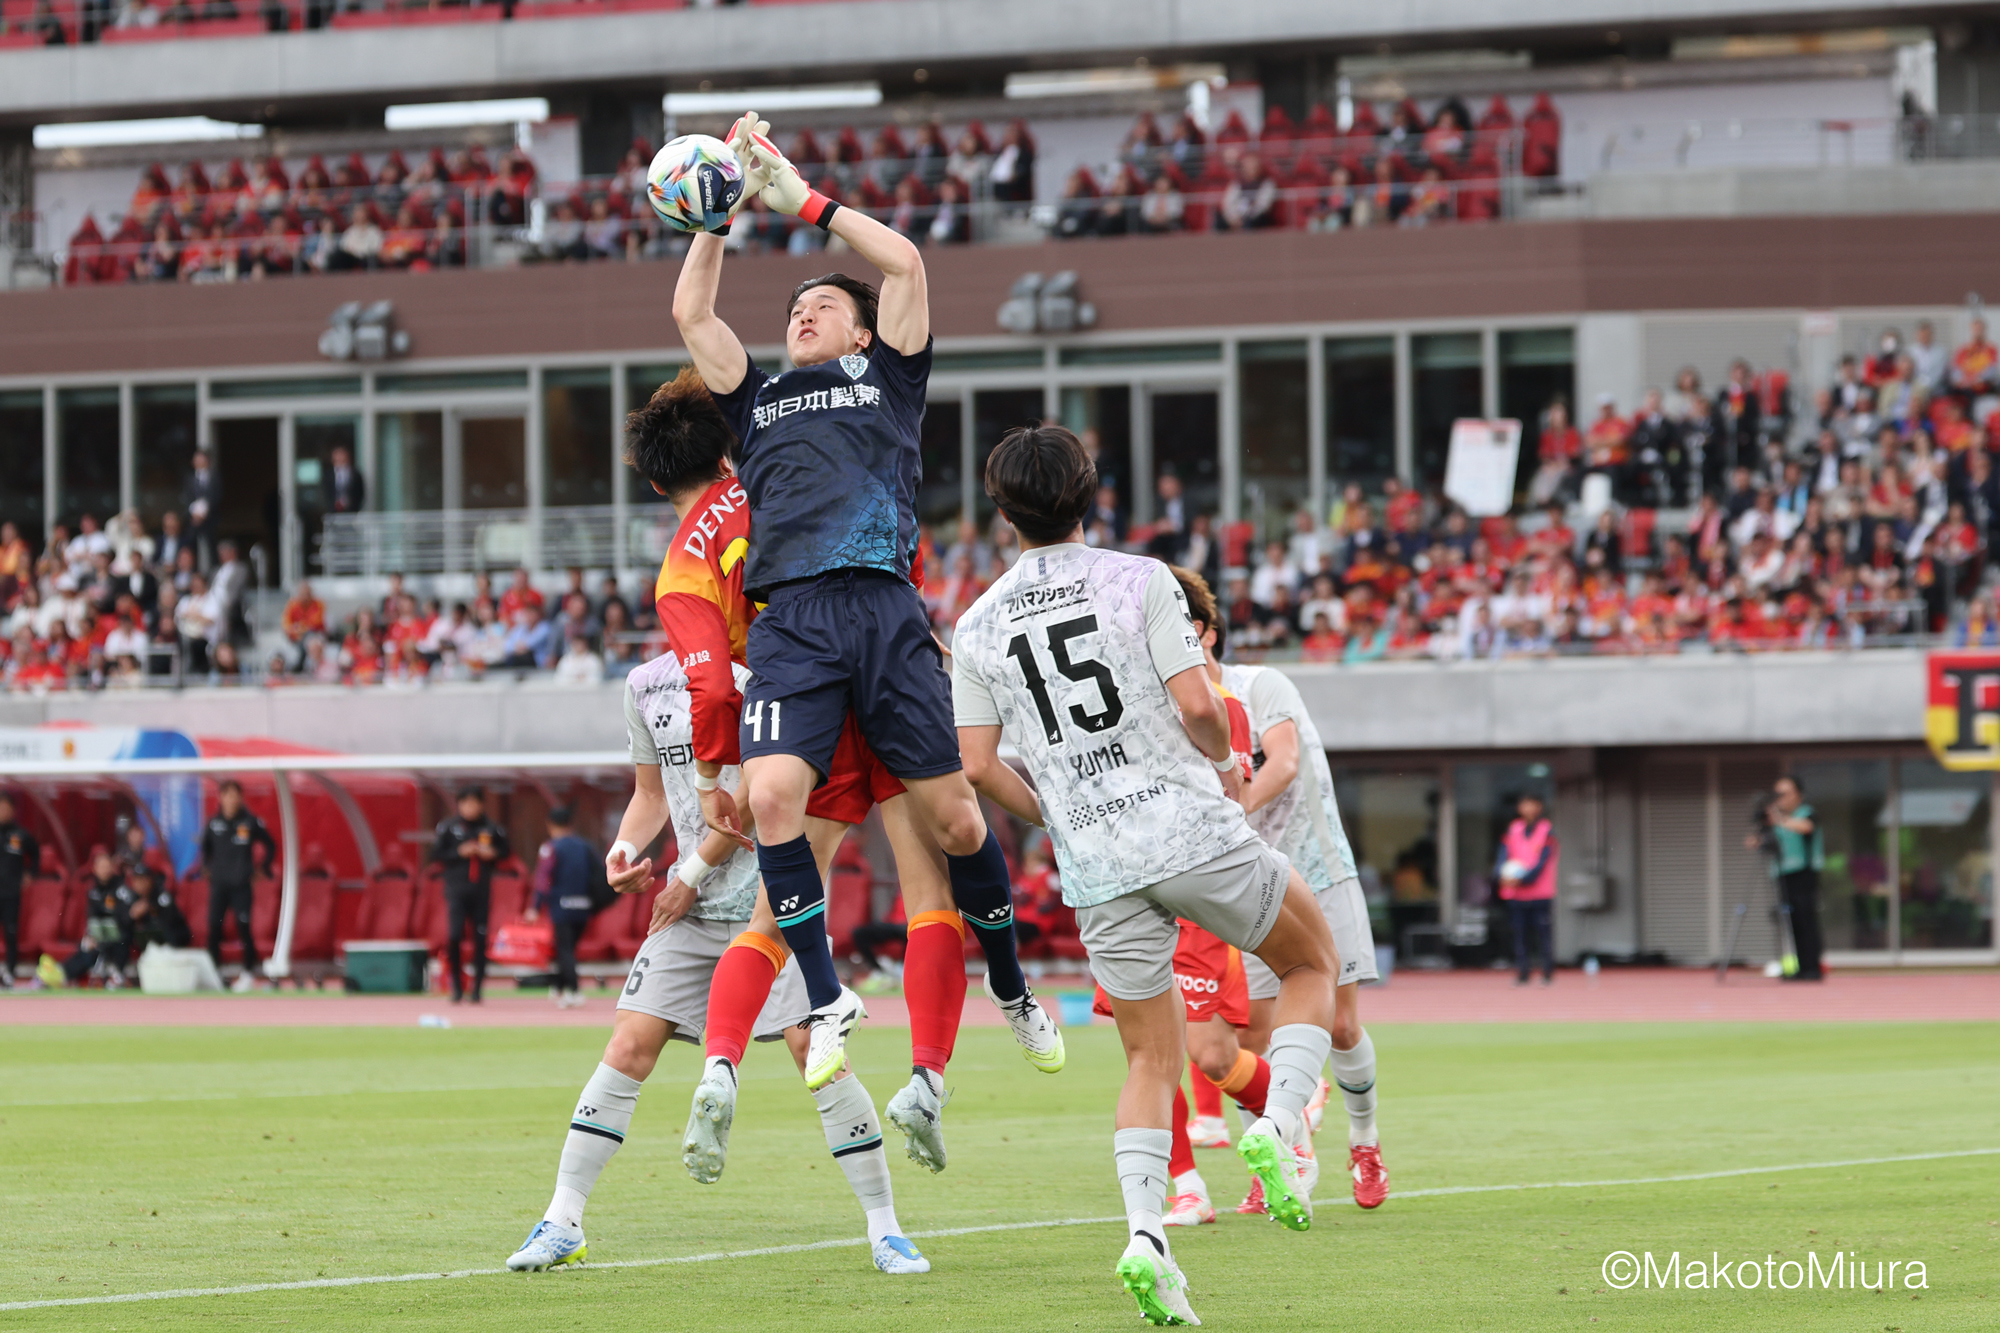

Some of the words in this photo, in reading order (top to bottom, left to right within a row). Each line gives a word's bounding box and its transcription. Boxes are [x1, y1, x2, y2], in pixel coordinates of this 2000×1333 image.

[702, 170, 712, 210] TSUBASA
[753, 383, 880, 430] 新日本製薬
[1006, 577, 1087, 614] アパマンショップ
[1006, 613, 1125, 747] 15
[744, 700, 781, 742] 41
[1069, 742, 1129, 780] YUMA
[1096, 783, 1167, 817] SEPTENI
[625, 957, 650, 996] 6
